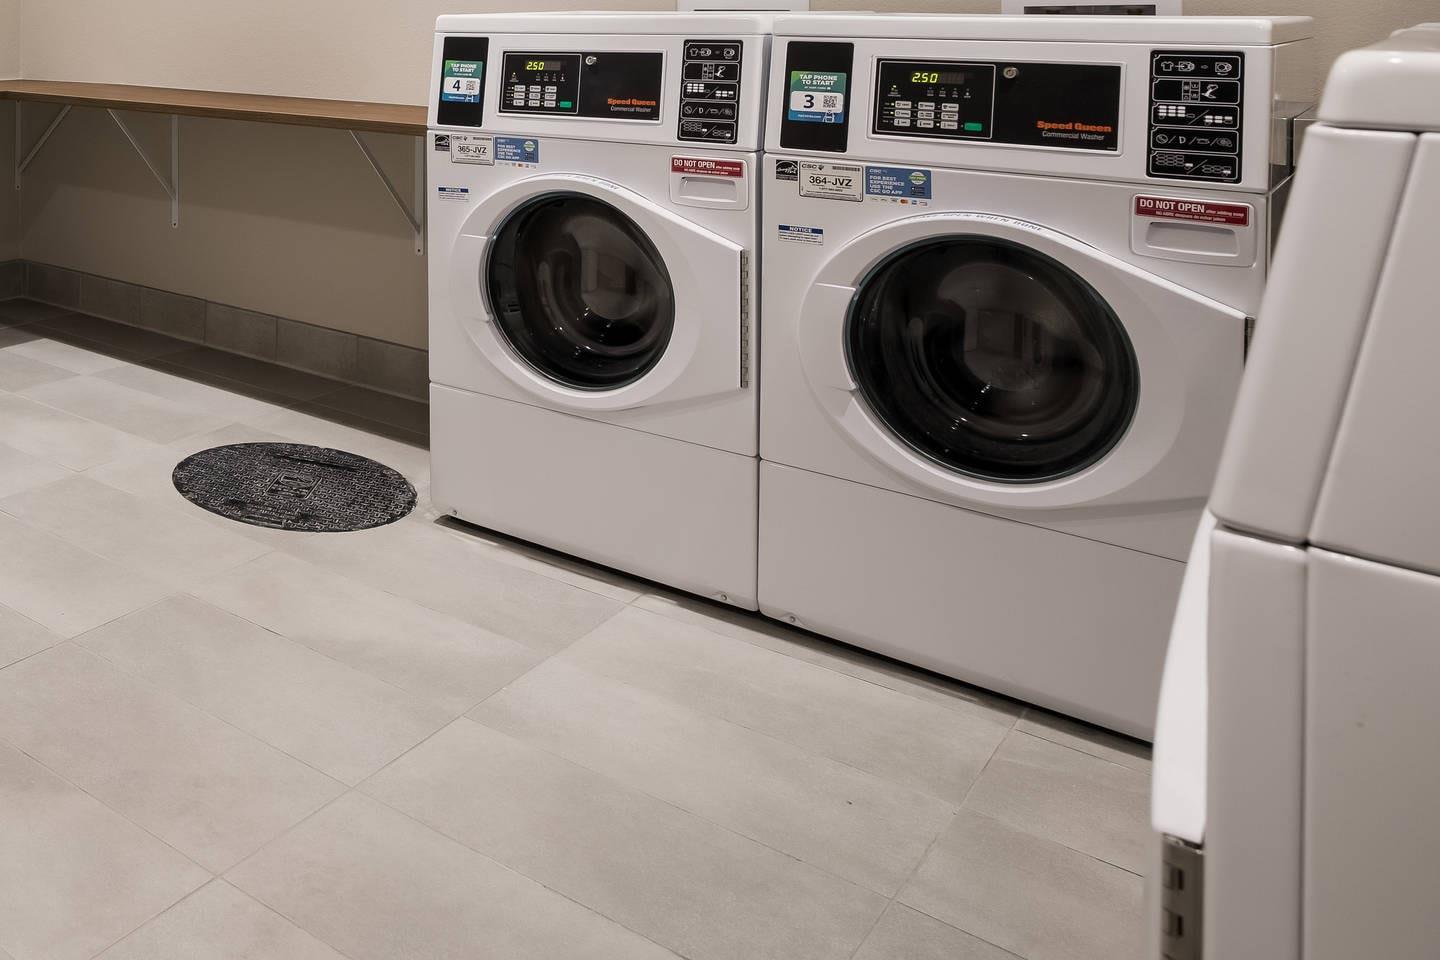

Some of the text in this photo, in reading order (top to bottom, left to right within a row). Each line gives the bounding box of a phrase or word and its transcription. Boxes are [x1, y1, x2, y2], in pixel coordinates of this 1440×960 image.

[911, 72, 938, 83] 2.50
[452, 80, 461, 92] 4
[803, 94, 815, 109] 3
[1037, 120, 1112, 132] Speed Queen
[1042, 130, 1079, 139] Commercial
[457, 145, 488, 154] 365-JVZ
[683, 160, 697, 168] NOT
[697, 161, 716, 169] OPEN
[808, 175, 853, 187] 364-JVZ
[1140, 198, 1154, 208] DO
[1155, 200, 1176, 210] NOT
[1177, 202, 1205, 213] OPEN
